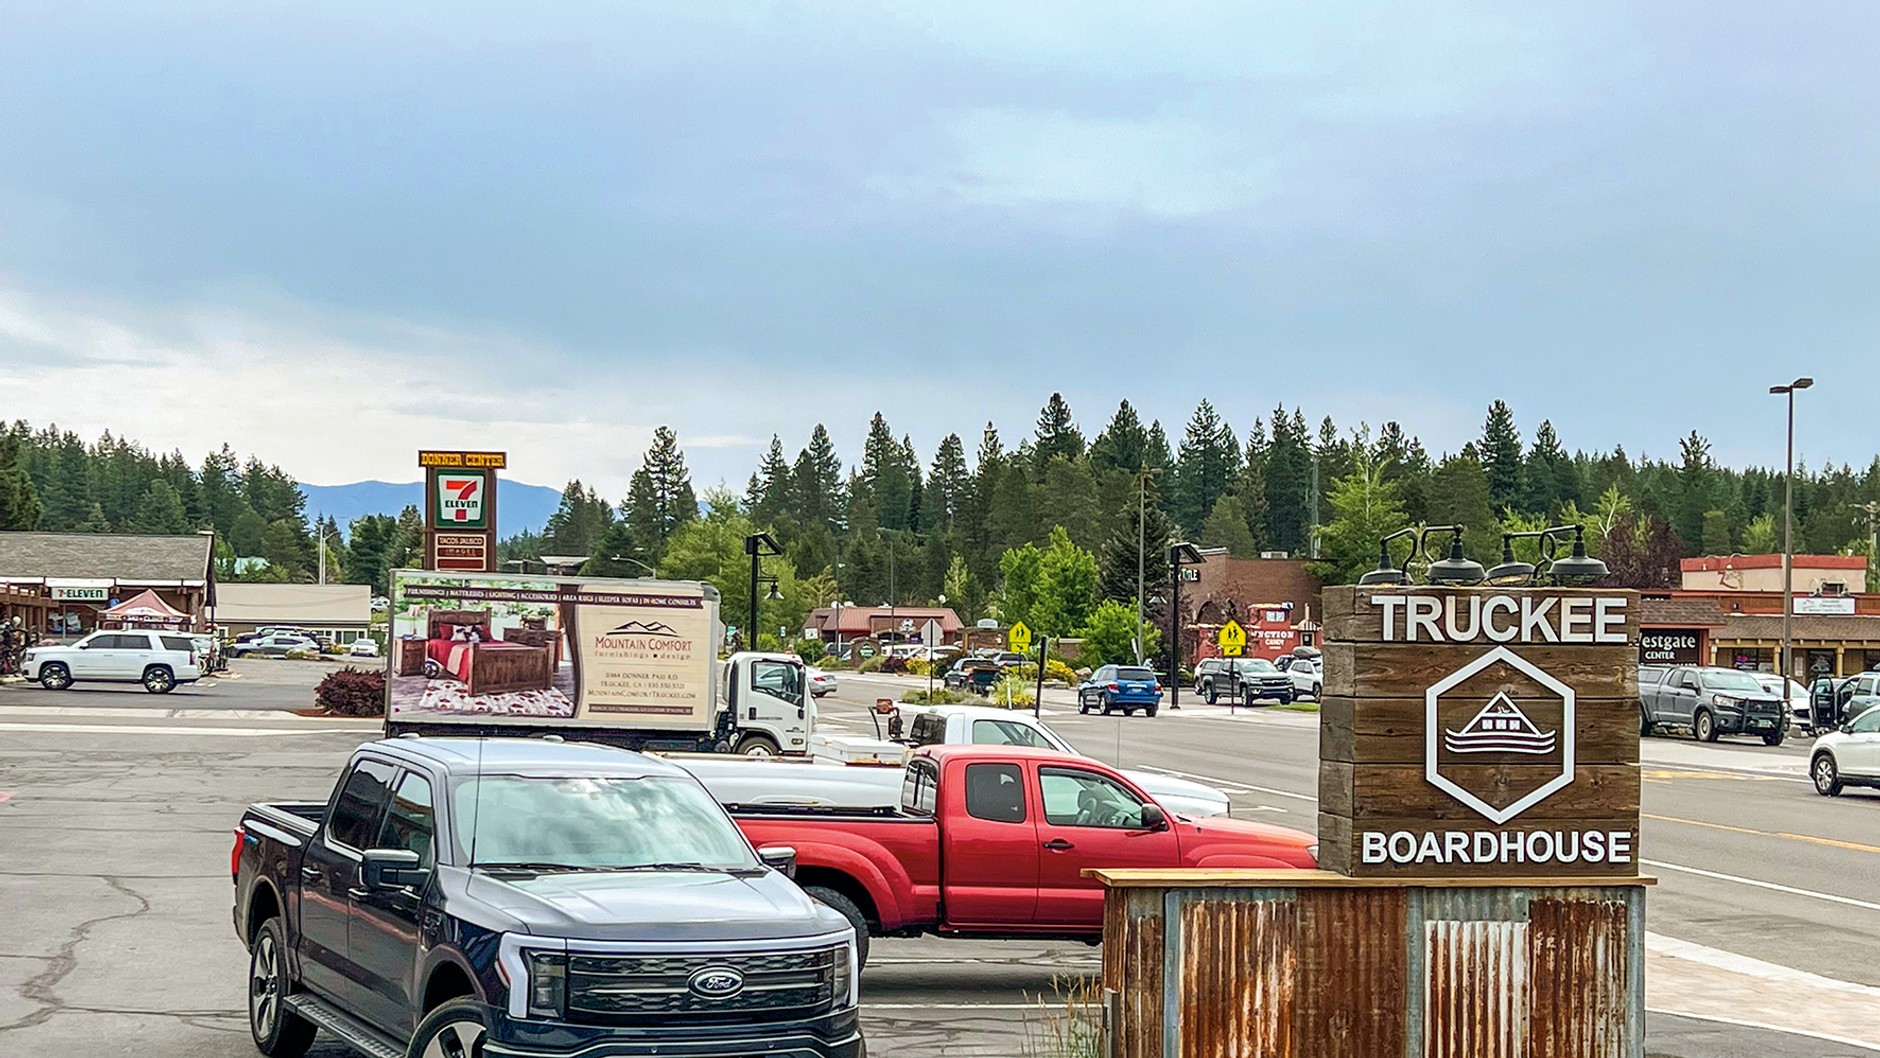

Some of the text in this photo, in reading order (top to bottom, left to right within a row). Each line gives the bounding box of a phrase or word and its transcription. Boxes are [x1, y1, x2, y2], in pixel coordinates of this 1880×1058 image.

[421, 453, 505, 467] DONNER CENTER
[439, 537, 459, 545] TACOS
[1371, 595, 1629, 643] TRUCKEE
[595, 636, 693, 652] MOUNTAIN COMFORT
[594, 650, 691, 661] furnishings design
[1644, 651, 1675, 660] CENTER
[622, 672, 650, 680] DONNER
[1361, 831, 1632, 865] BOARDHOUSE
[706, 976, 733, 989] Ford
